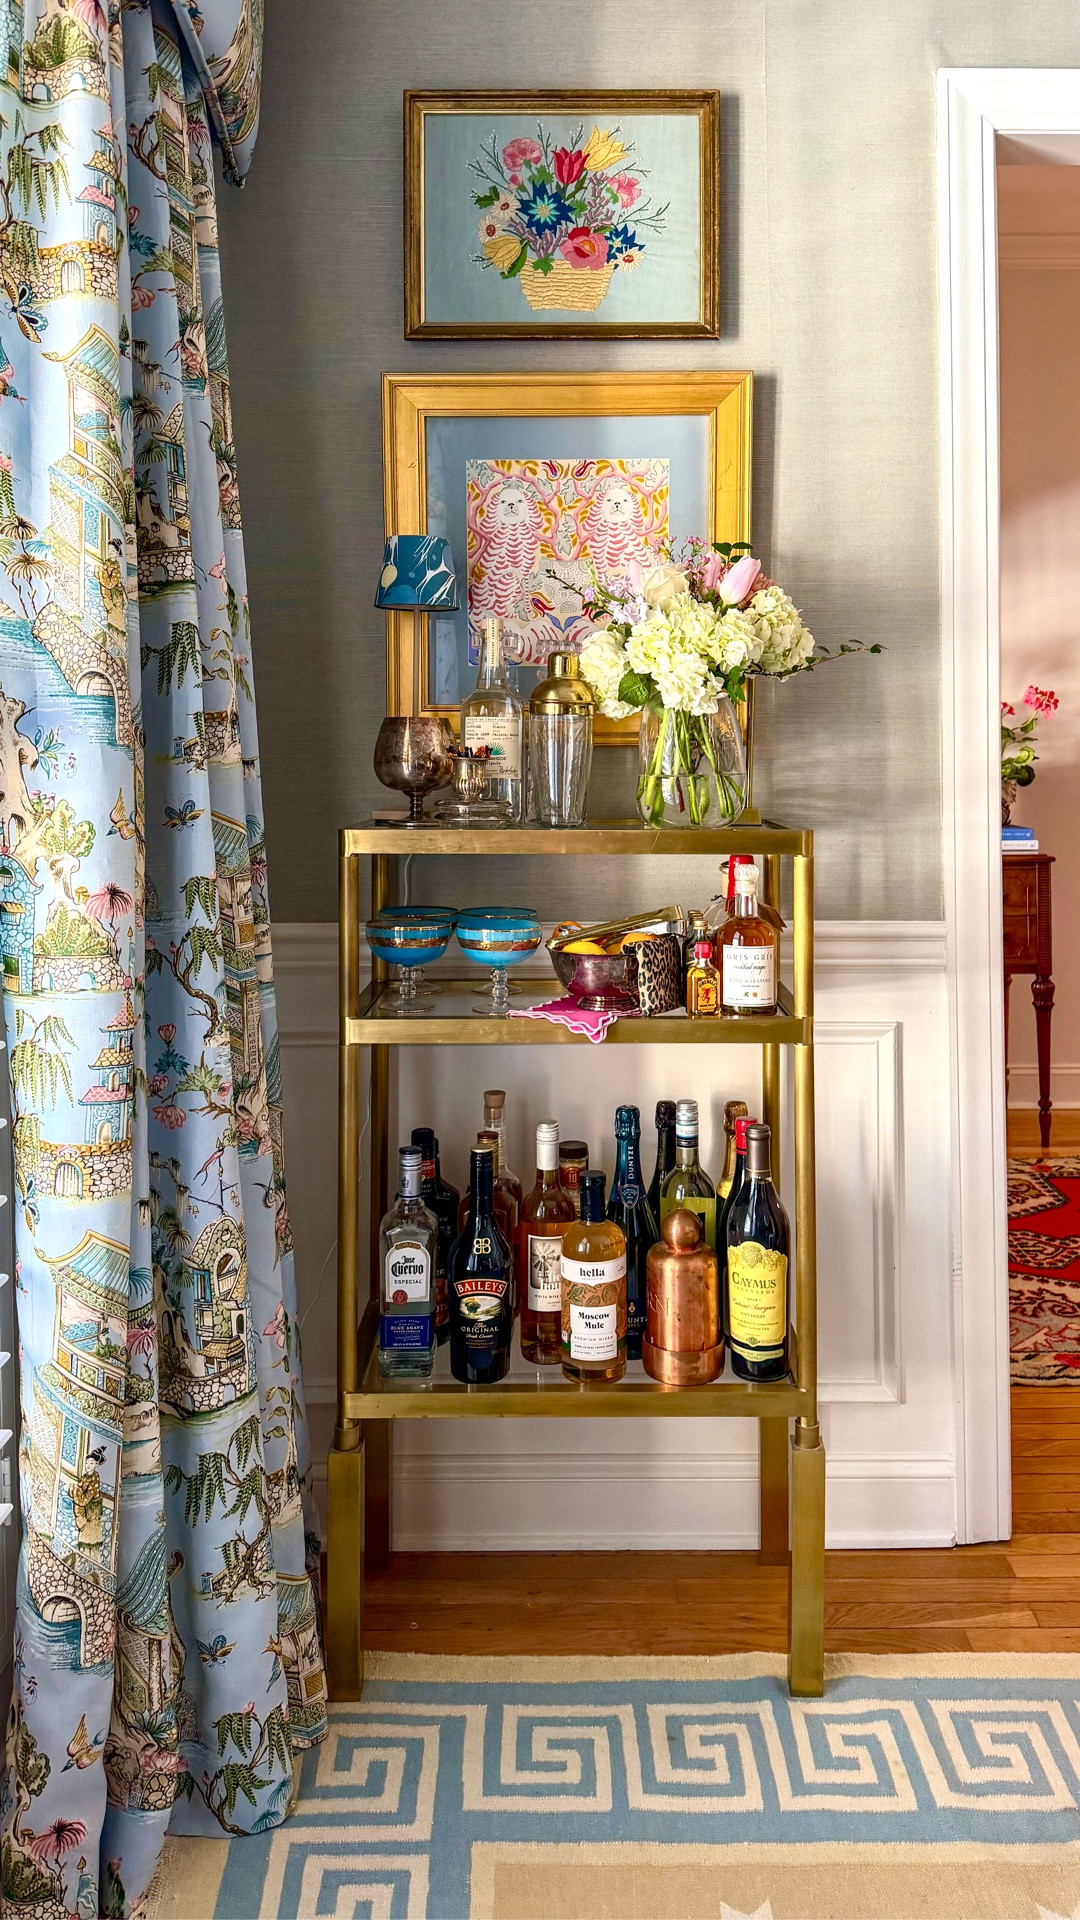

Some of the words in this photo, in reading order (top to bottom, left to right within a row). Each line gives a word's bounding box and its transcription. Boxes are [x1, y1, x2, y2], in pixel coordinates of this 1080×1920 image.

[402, 1256, 415, 1264] Jose
[391, 1261, 424, 1278] Cuervo
[579, 1267, 606, 1277] hella
[731, 1271, 777, 1289] CAYMUS
[457, 1281, 505, 1294] BAILEYS
[578, 1311, 611, 1320] Moscow
[460, 1325, 499, 1333] ORIGINAL
[584, 1321, 605, 1329] Mule
